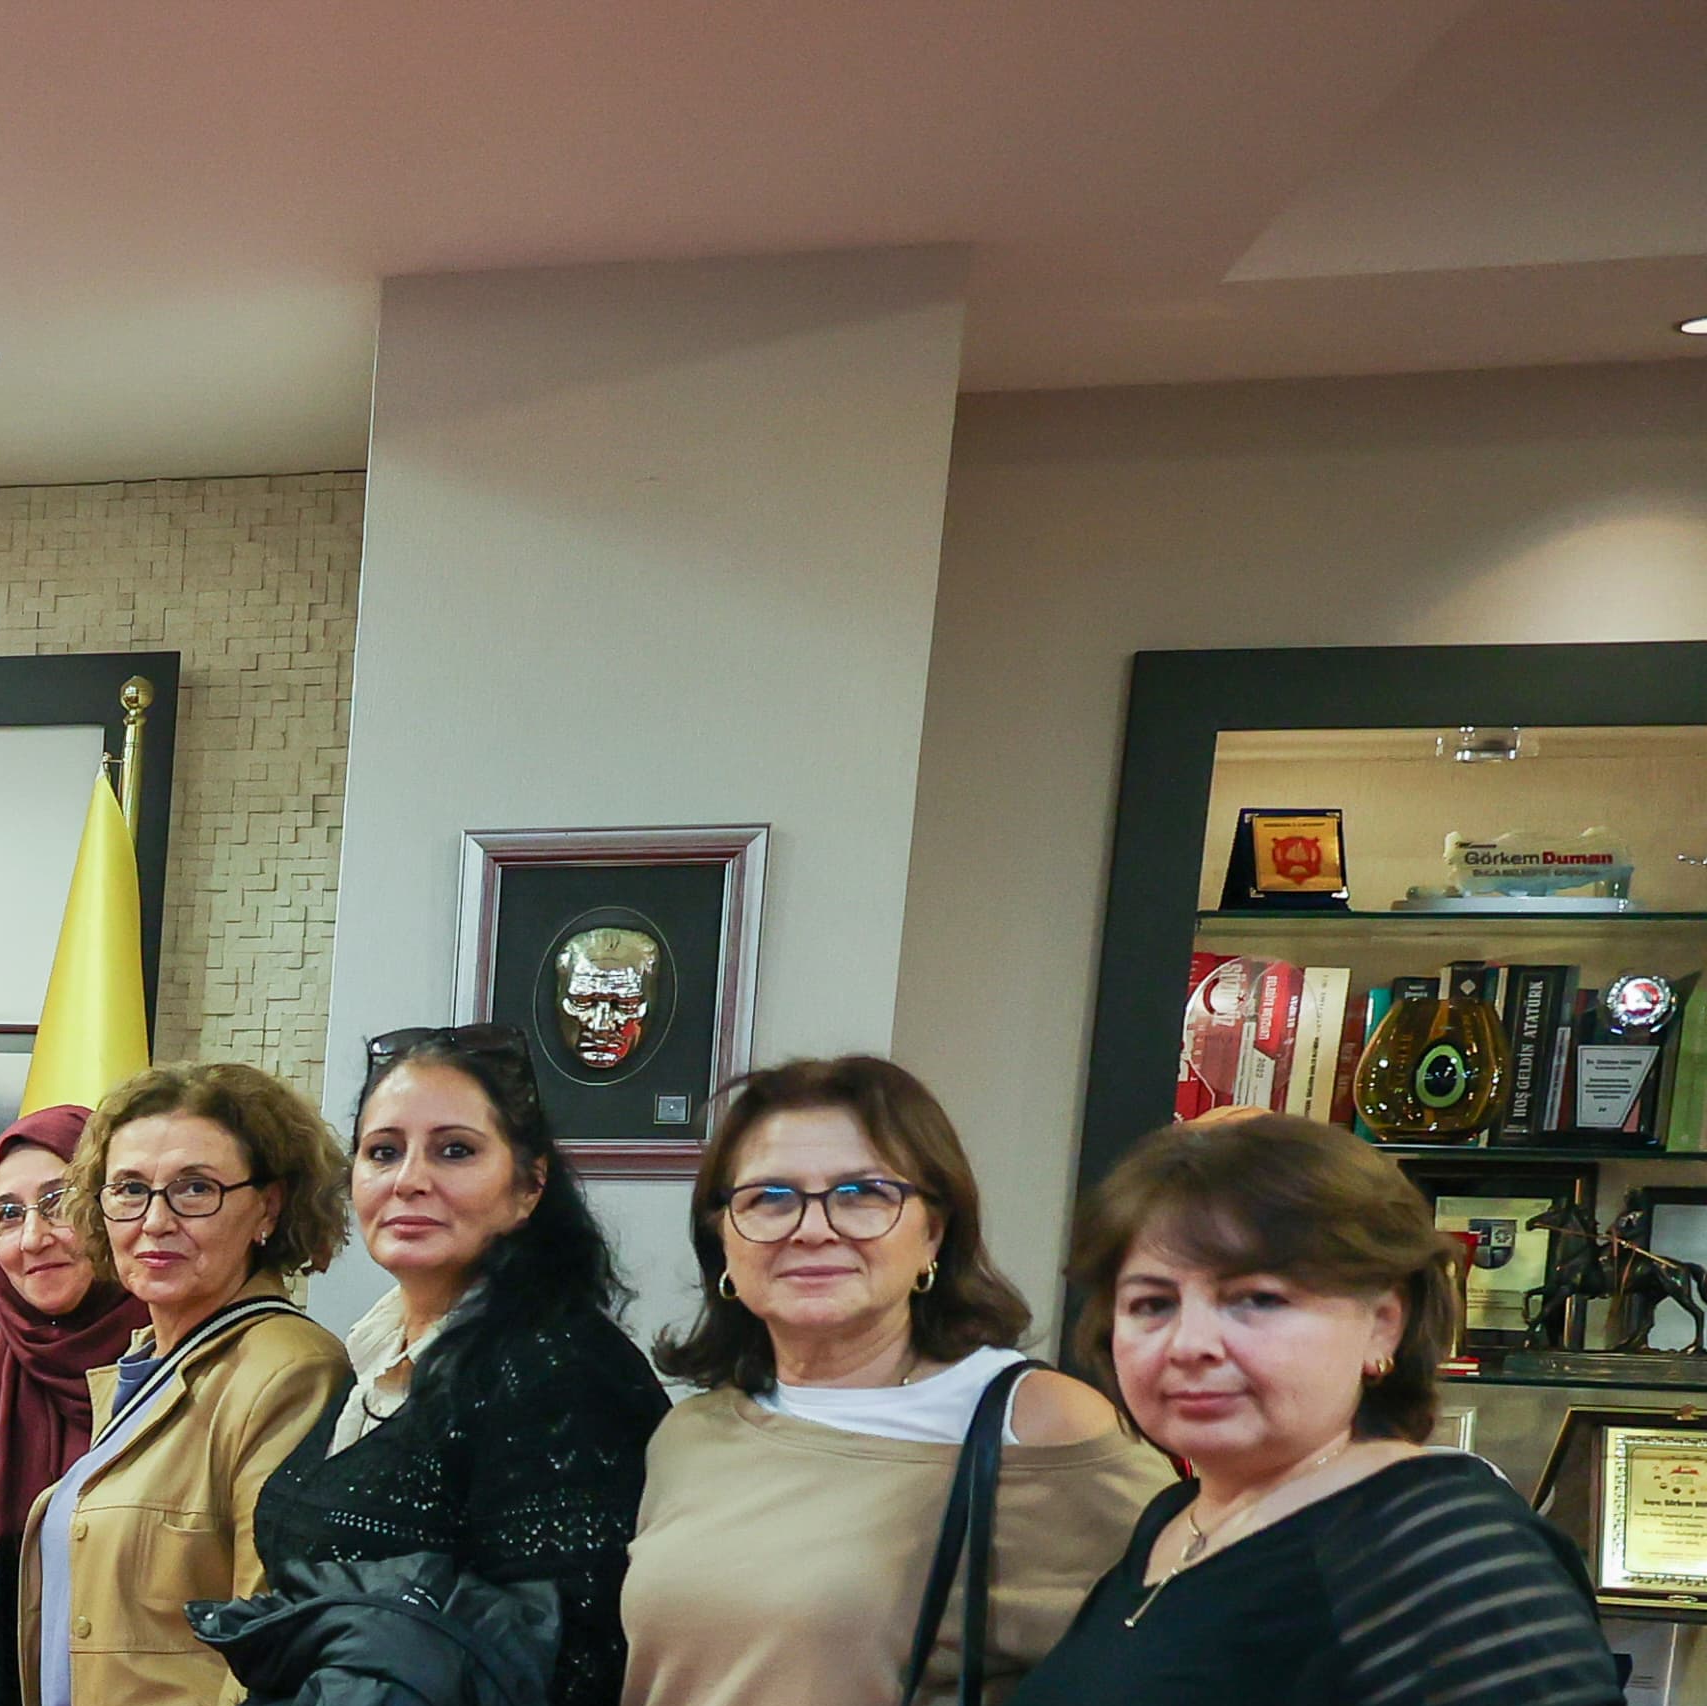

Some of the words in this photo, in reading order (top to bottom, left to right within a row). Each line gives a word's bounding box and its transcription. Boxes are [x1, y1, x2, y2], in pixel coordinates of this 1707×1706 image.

[1465, 850, 1539, 865] Görkem
[1542, 851, 1613, 865] Duman
[1523, 980, 1544, 1038] ATATÜRK
[1516, 1043, 1535, 1090] GELDİN
[1513, 1091, 1530, 1117] HOŞ
